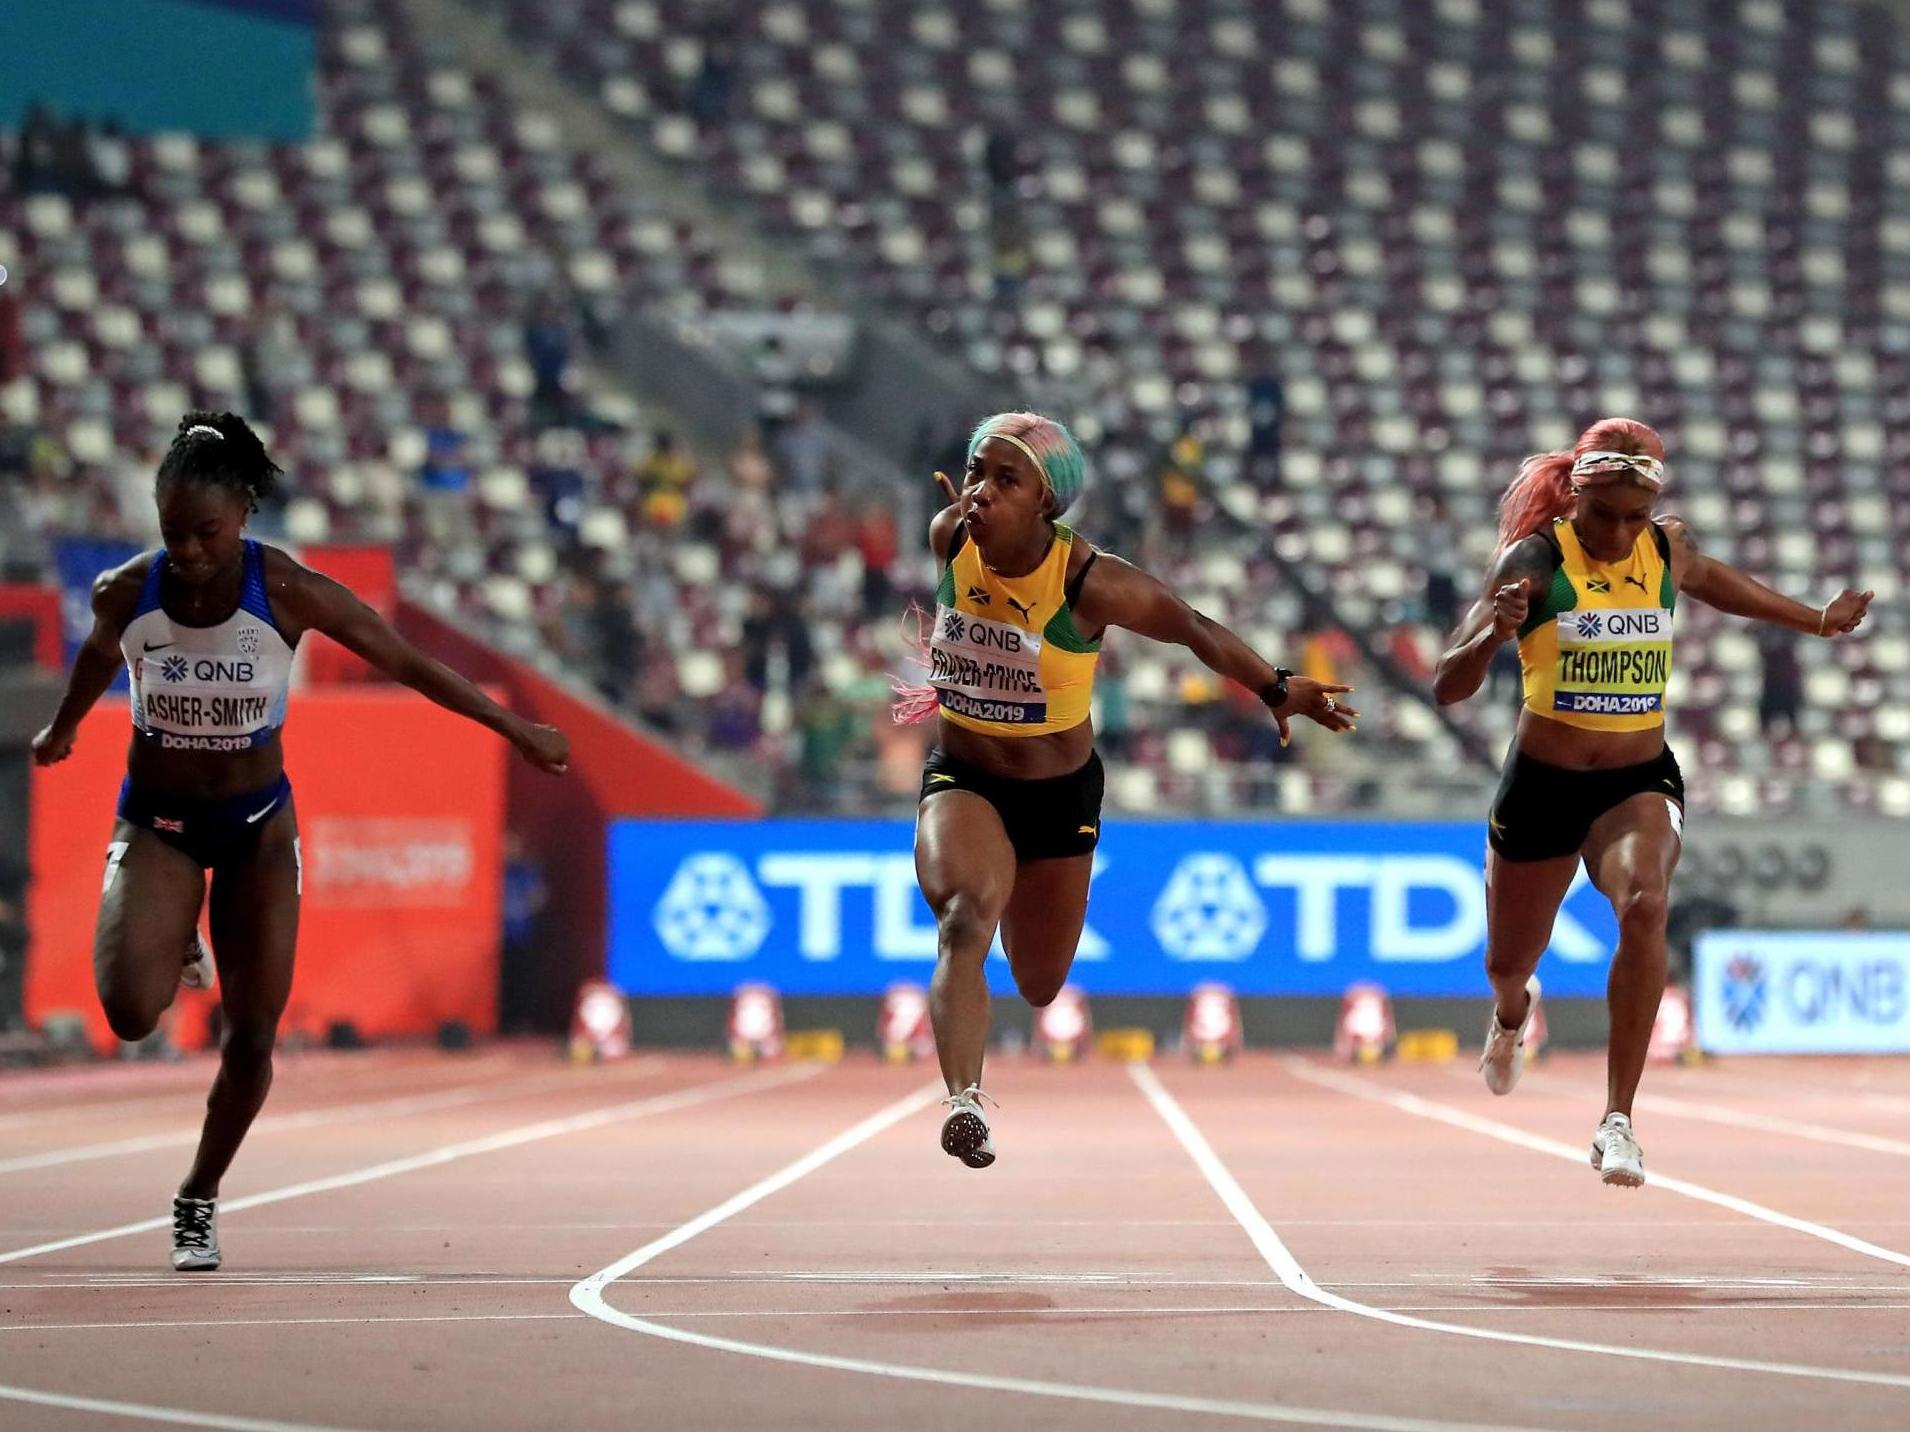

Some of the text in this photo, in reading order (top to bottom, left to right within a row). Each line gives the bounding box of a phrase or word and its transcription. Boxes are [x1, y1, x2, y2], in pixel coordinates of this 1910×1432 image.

[1608, 614, 1660, 634] QNB
[969, 622, 1021, 653] QNB
[194, 660, 254, 682] QNB
[1561, 650, 1667, 684] THOMPSON
[147, 694, 267, 727] ASHER-SMITH
[946, 691, 1025, 721] DOHA2019
[1573, 695, 1658, 713] DOHA2019
[161, 734, 251, 751] DOHA2019
